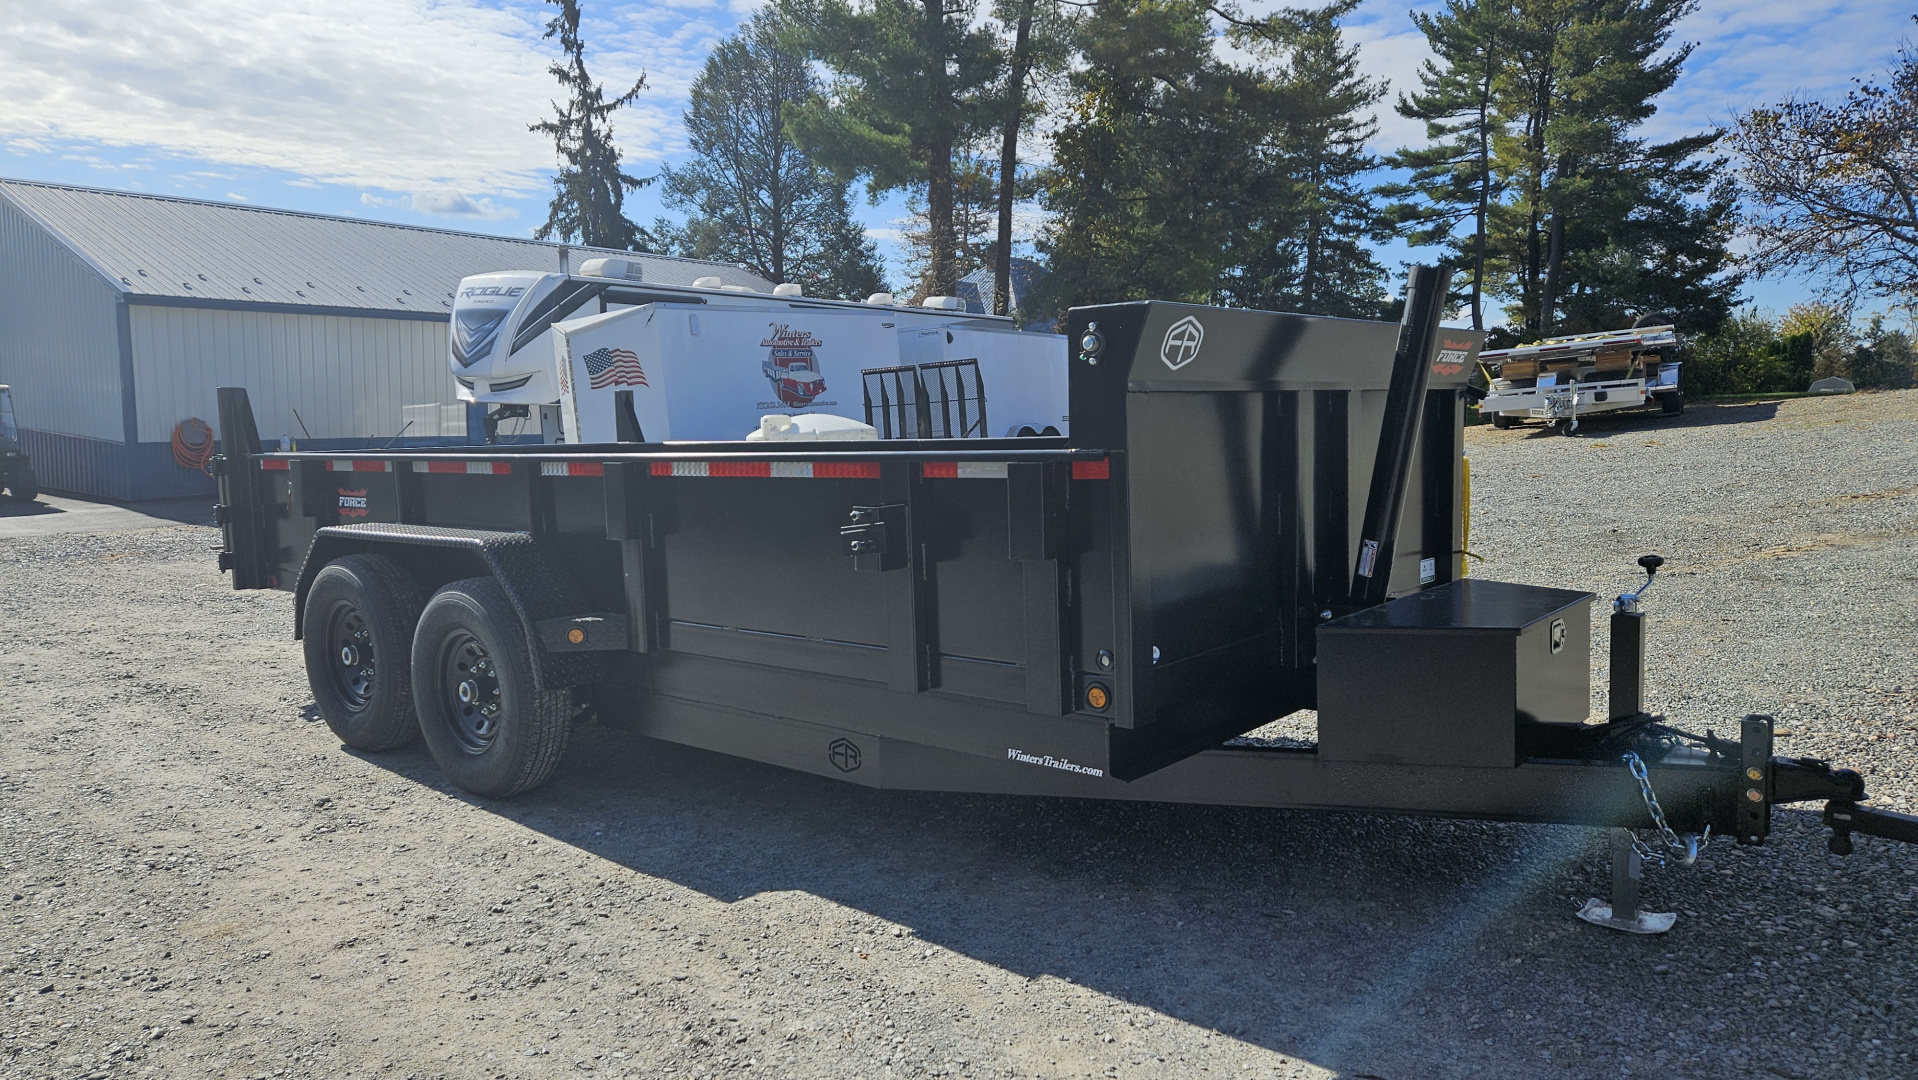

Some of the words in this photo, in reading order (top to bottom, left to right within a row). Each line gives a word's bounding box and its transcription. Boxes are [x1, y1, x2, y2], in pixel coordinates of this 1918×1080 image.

[459, 286, 525, 299] ROGUE
[768, 321, 812, 341] Winters
[793, 338, 800, 346] &
[801, 338, 823, 347] Trailers
[1436, 349, 1469, 363] FORCE
[338, 496, 367, 508] FORCE
[1007, 748, 1104, 778] WintersTrailers.com
